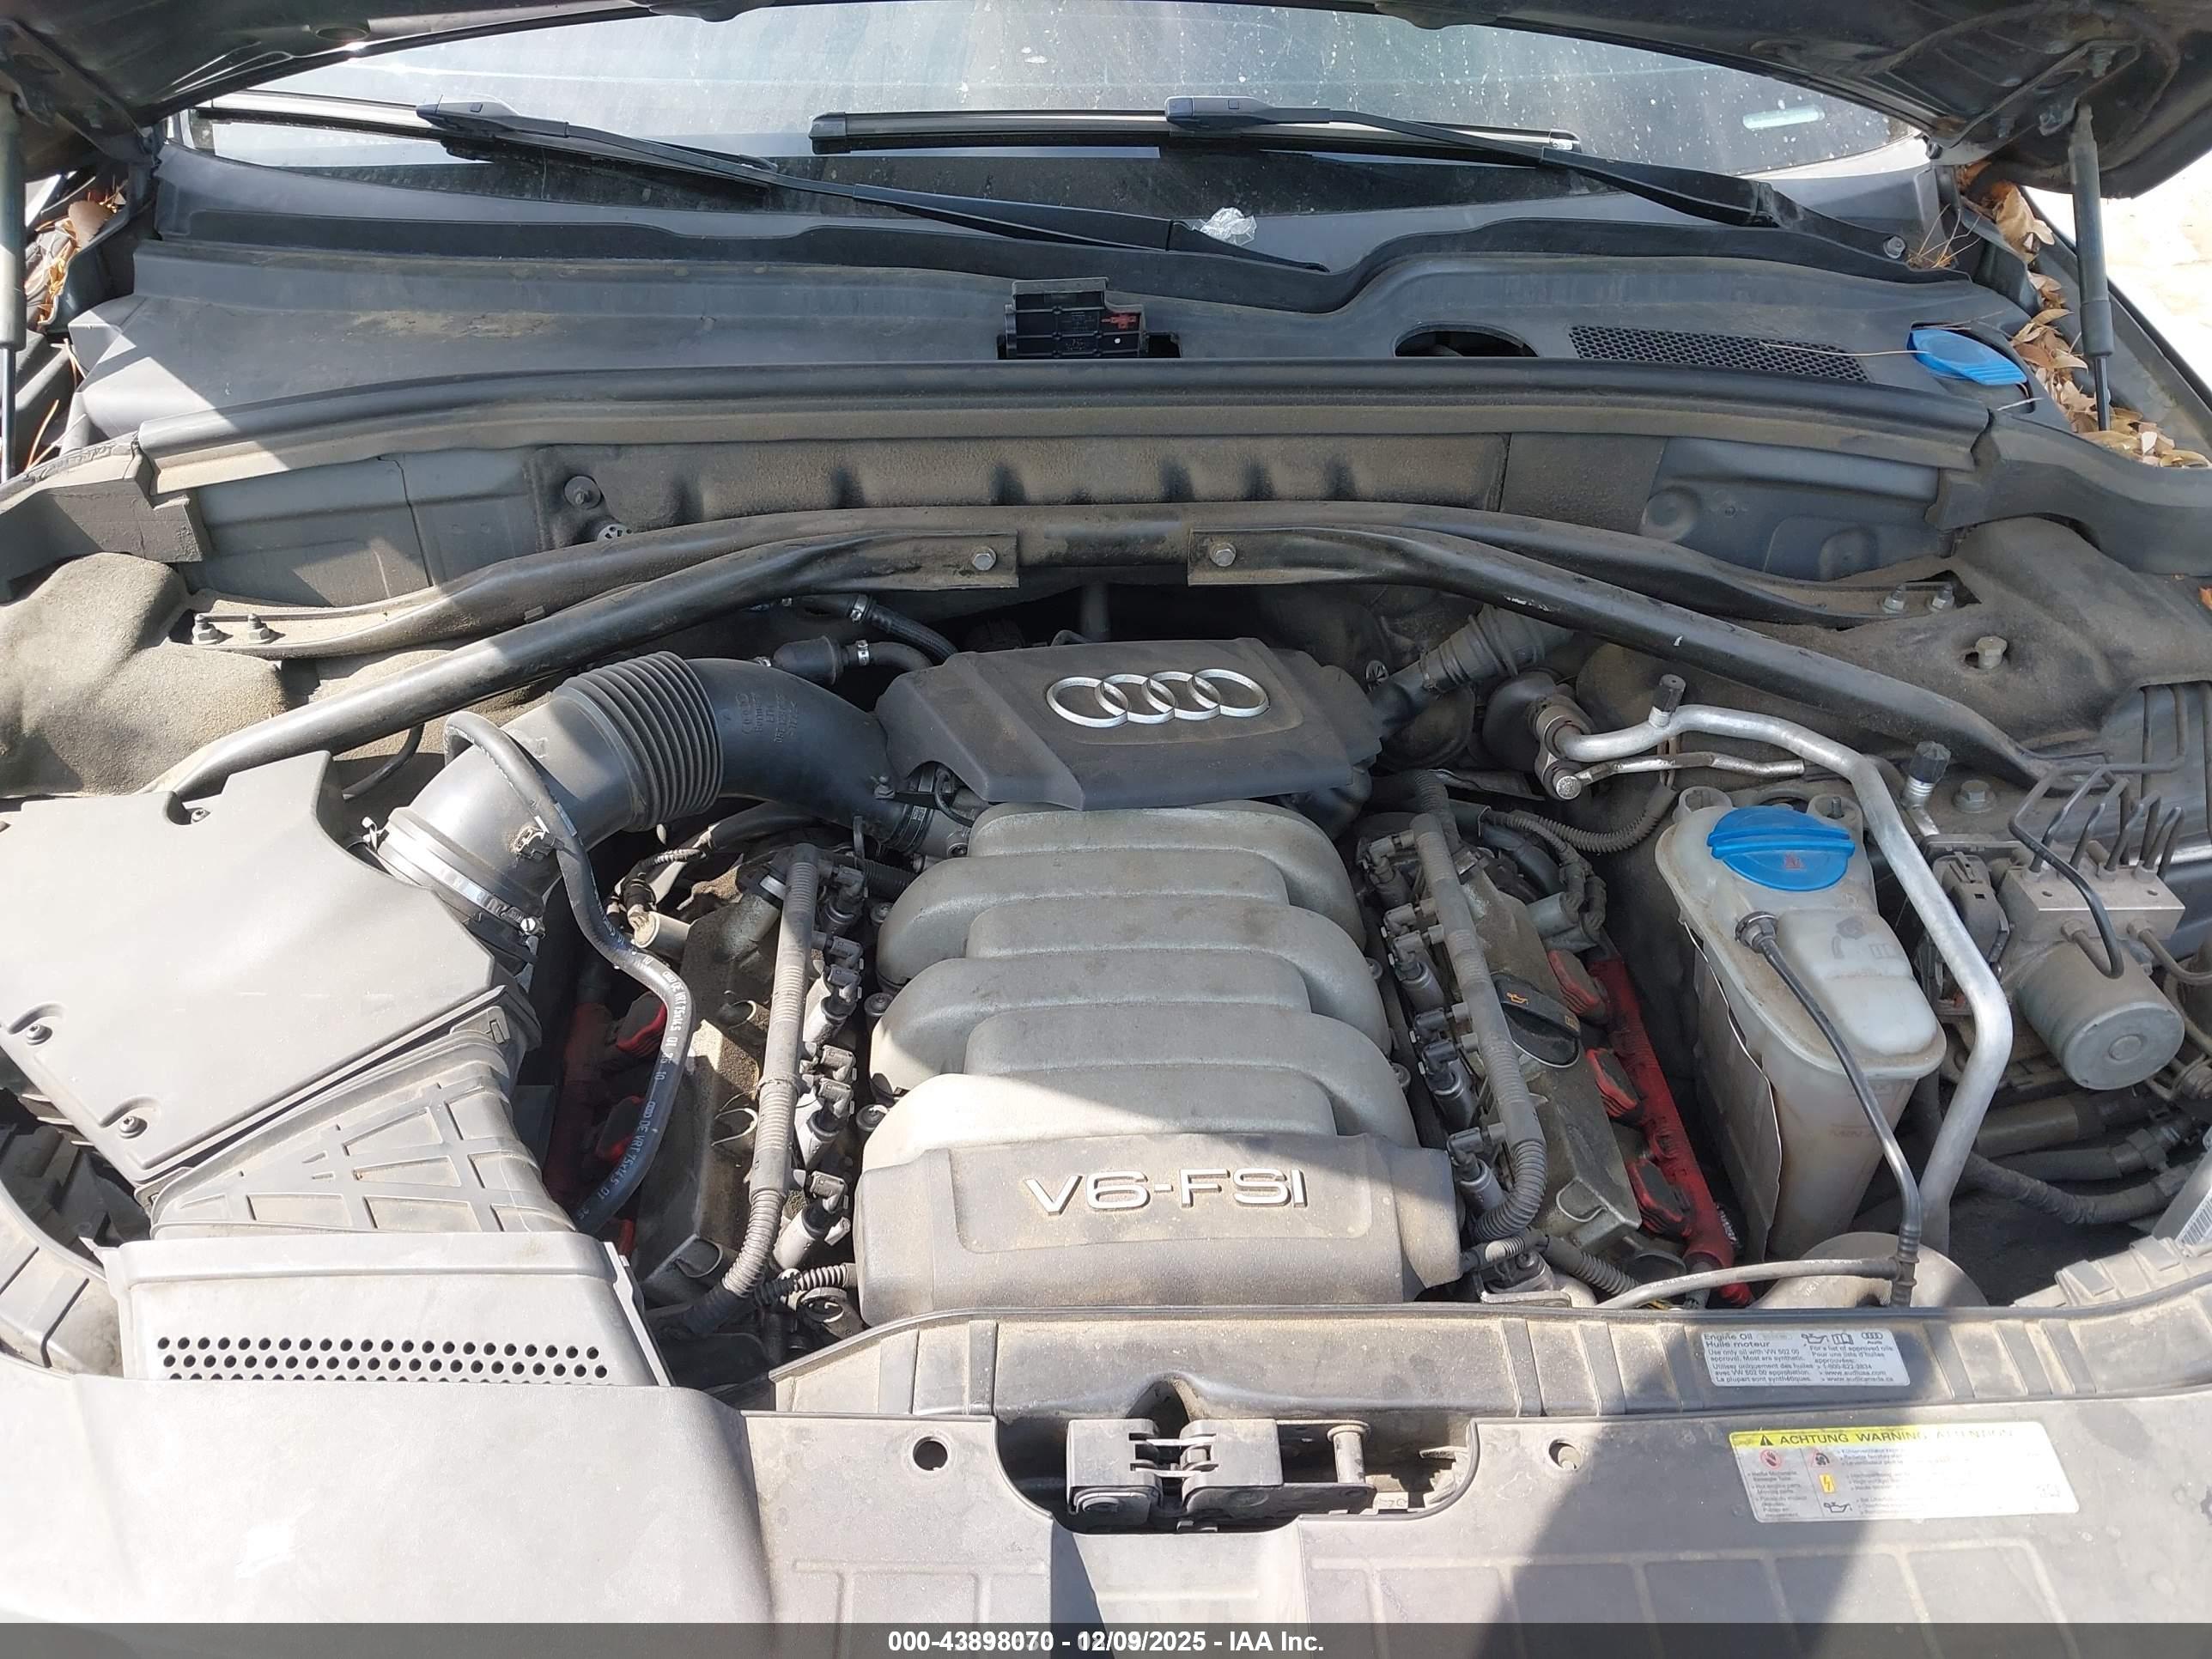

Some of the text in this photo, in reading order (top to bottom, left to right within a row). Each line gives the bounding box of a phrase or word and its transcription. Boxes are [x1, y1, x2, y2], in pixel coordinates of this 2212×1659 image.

[632, 1134, 646, 1152] VRT
[1023, 1167, 1309, 1217] V6-FSI
[1704, 1333, 1736, 1341] Engine
[1780, 1433, 1849, 1444] ACHTUNG
